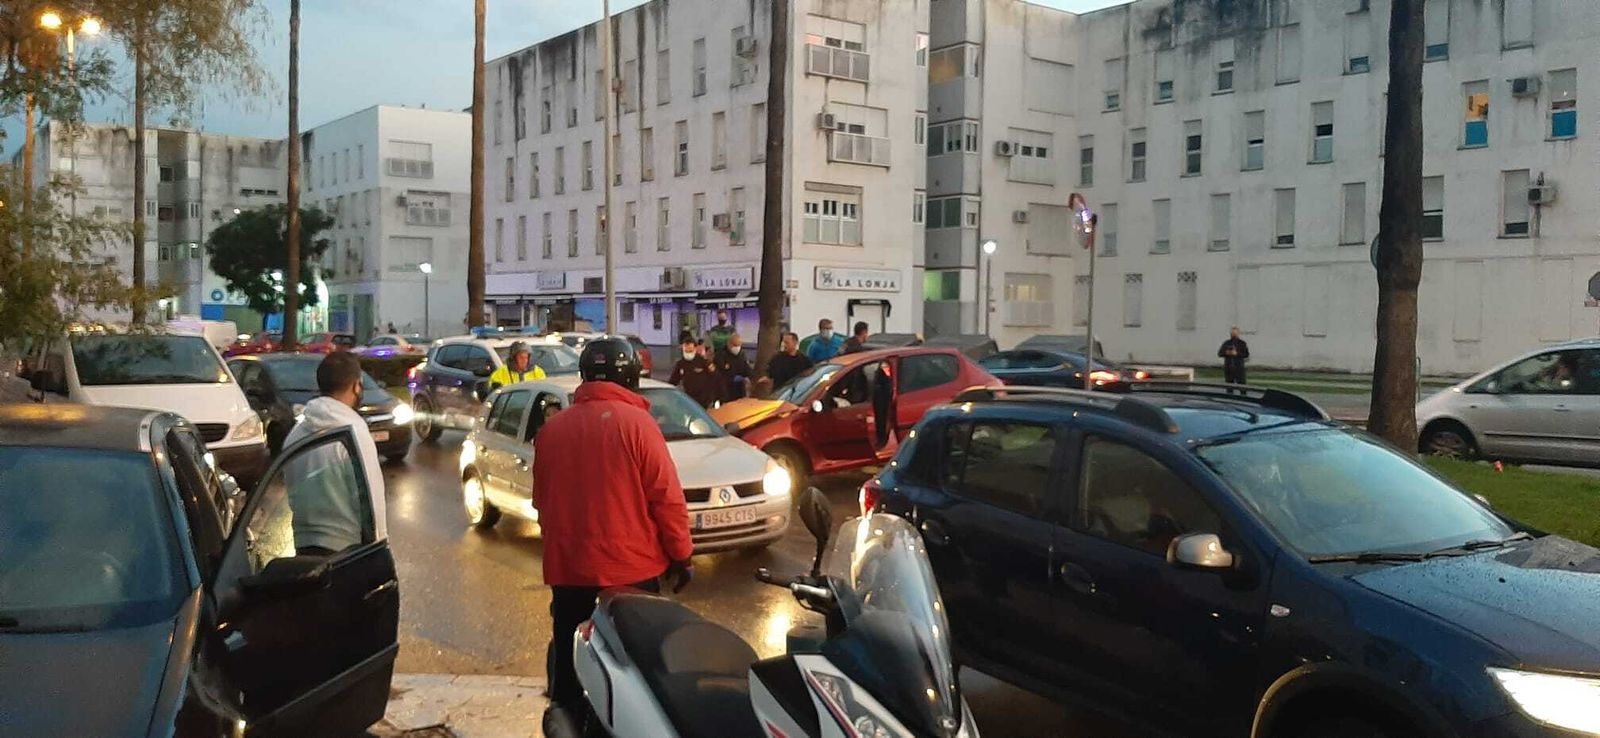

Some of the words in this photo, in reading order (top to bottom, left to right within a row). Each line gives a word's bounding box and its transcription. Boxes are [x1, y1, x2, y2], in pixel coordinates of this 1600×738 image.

[705, 279, 716, 287] LA
[720, 278, 748, 287] LONJA
[837, 279, 851, 287] LA
[858, 280, 896, 288] LONJA
[704, 511, 732, 526] 9945
